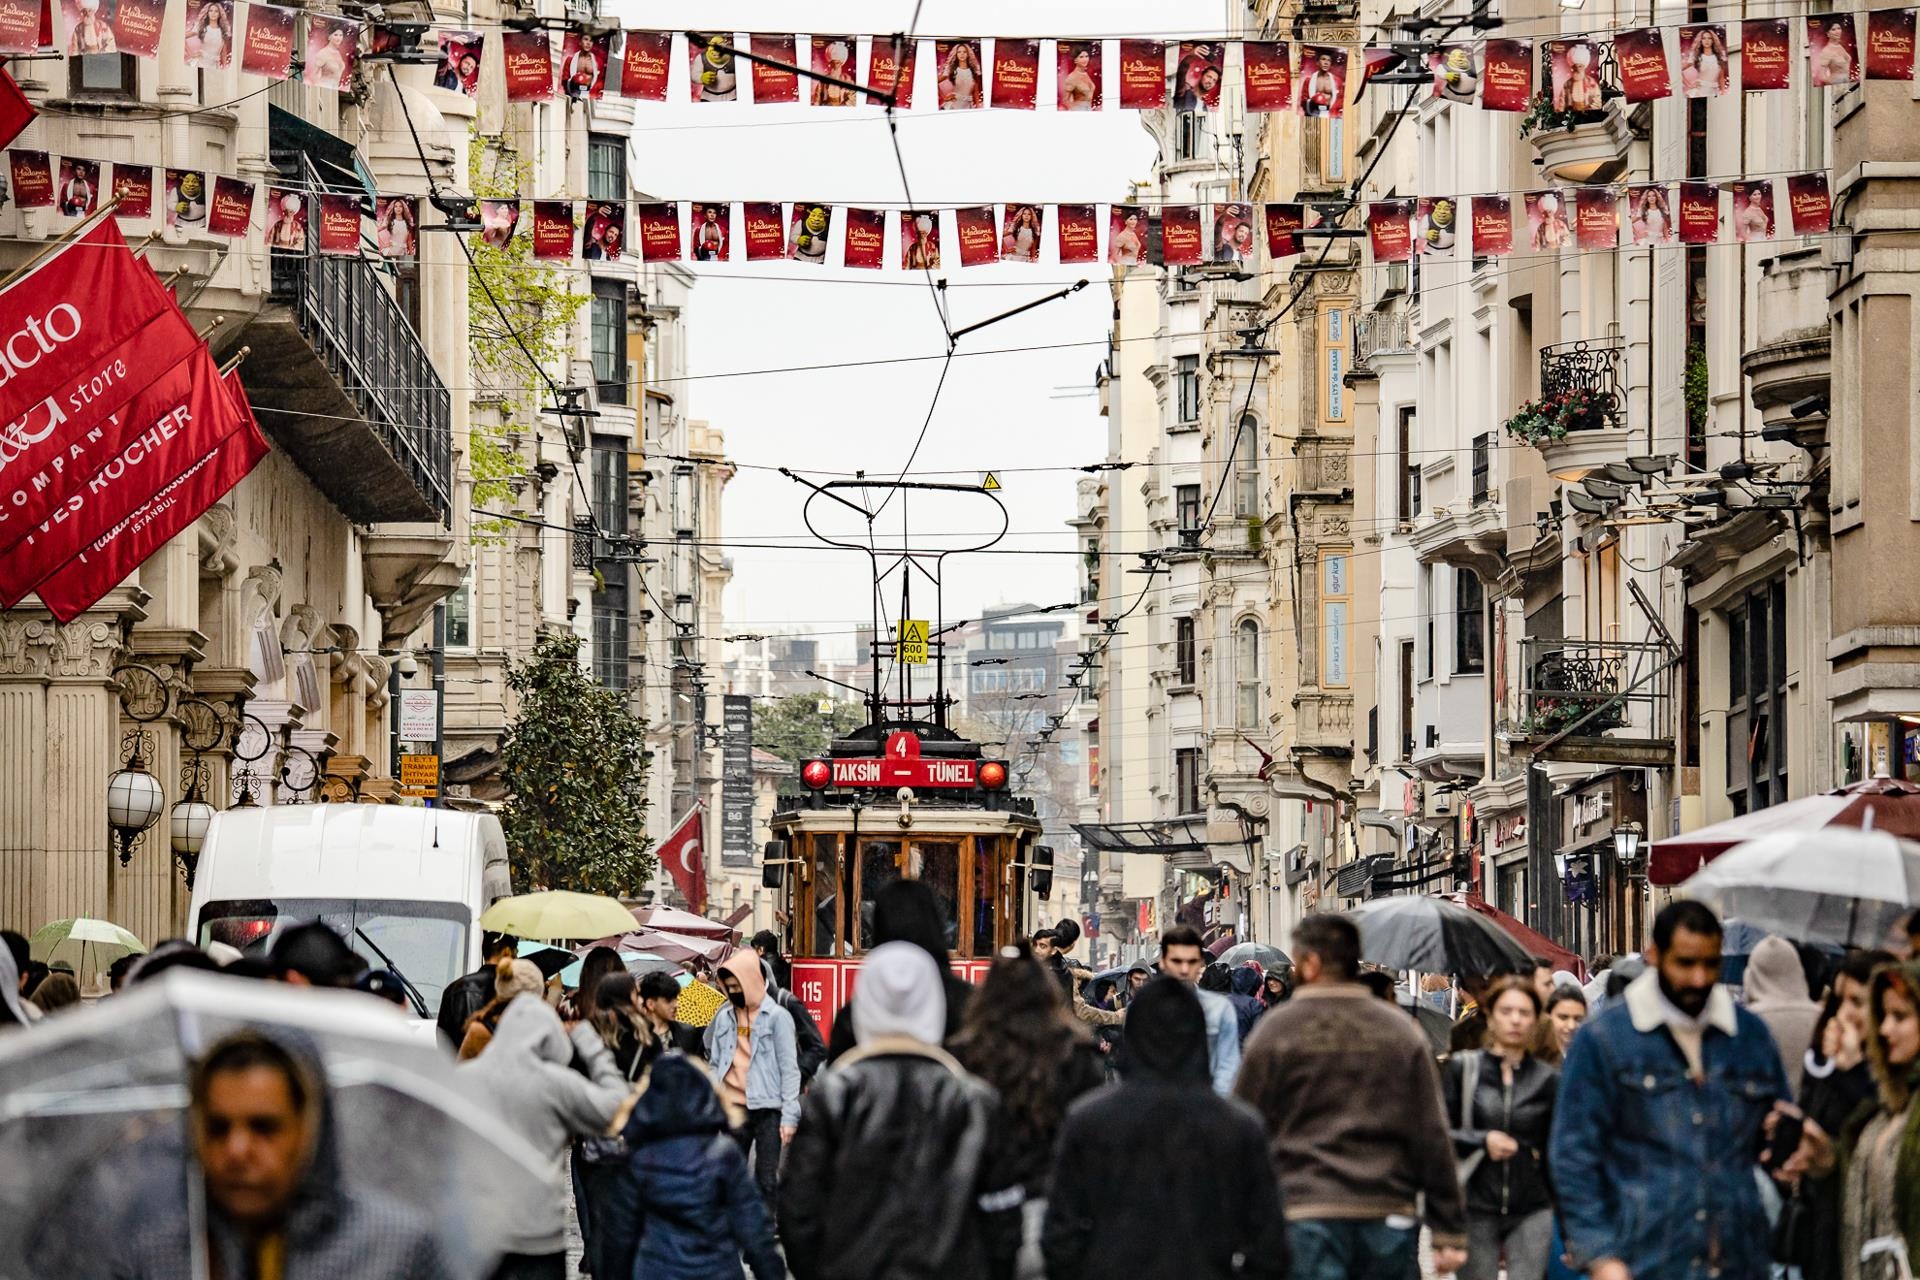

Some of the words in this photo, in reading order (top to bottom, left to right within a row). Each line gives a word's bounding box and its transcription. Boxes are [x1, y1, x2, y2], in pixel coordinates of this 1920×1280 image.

[120, 4, 158, 22] Madame
[120, 15, 156, 32] Tussauds
[250, 26, 288, 44] Madame
[1872, 31, 1911, 44] Madame
[250, 37, 286, 52] Tussauds
[1746, 41, 1785, 54] Madame
[1872, 42, 1910, 53] Tussauds
[508, 53, 548, 65] Madame
[628, 51, 665, 65] Madame
[1623, 53, 1662, 68] Madame
[1746, 52, 1784, 62] Tussauds
[509, 62, 547, 75] Tussauds
[628, 61, 664, 75] Tussauds
[996, 60, 1034, 73] Madame
[1123, 60, 1161, 73] Madame
[1248, 63, 1286, 76] Madame
[1488, 61, 1527, 75] Madame
[1624, 62, 1663, 77] Tussauds
[996, 71, 1033, 83] Tussauds
[1124, 71, 1161, 83] Tussauds
[1248, 73, 1286, 86] Tussauds
[1488, 72, 1525, 85] Tussauds
[14, 166, 48, 178] Madame
[16, 174, 48, 184] Tussauds
[215, 194, 248, 208] Madame
[1793, 194, 1826, 205] Madame
[216, 204, 246, 216] Tussauds
[1580, 207, 1612, 218] Madame
[1683, 201, 1714, 212] Madame
[1794, 201, 1827, 213] Tussauds
[324, 212, 357, 223] Madame
[1475, 215, 1508, 226] Madame
[1580, 216, 1612, 226] Tussauds
[1683, 210, 1714, 220] Tussauds
[325, 221, 356, 232] Tussauds
[537, 220, 569, 231] Madame
[644, 221, 676, 232] Madame
[748, 220, 780, 230] Madame
[961, 225, 993, 236] Madame
[1062, 223, 1093, 233] Madame
[1166, 225, 1198, 235] Madame
[1374, 221, 1406, 232] Madame
[1476, 224, 1507, 234] Tussauds
[538, 228, 569, 239] Tussauds
[645, 230, 676, 240] Tussauds
[749, 228, 780, 238] Tussauds
[848, 226, 880, 239] Madame
[1062, 231, 1093, 241] Tussauds
[1166, 233, 1197, 243] Tussauds
[1375, 230, 1407, 240] Tussauds
[849, 235, 880, 247] Tussauds
[962, 233, 993, 245] Tussauds
[69, 359, 126, 413] store
[131, 496, 177, 534] ISTANBUL
[904, 644, 922, 654] 600
[896, 737, 906, 758] 4
[833, 761, 880, 782] TAKSİM
[927, 761, 974, 782] TÜNEL
[802, 981, 822, 1002] 115
